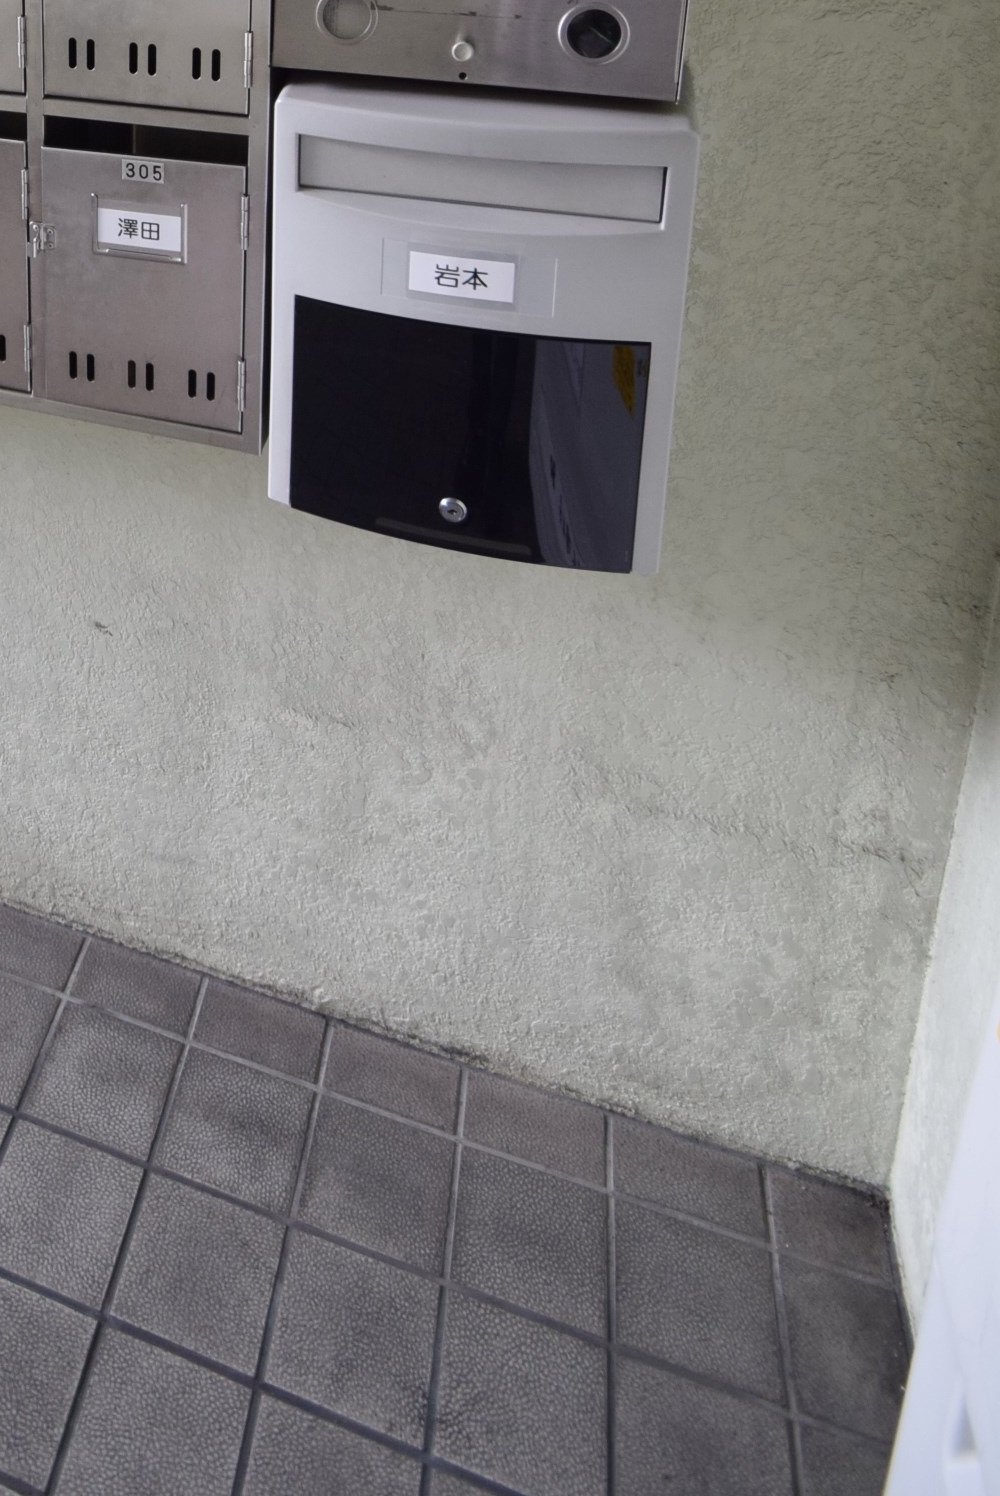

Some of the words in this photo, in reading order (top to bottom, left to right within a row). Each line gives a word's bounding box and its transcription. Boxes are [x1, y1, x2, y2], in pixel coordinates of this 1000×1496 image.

[125, 162, 162, 181] 305
[117, 217, 160, 241] 澤田
[434, 263, 489, 291] 岩本
